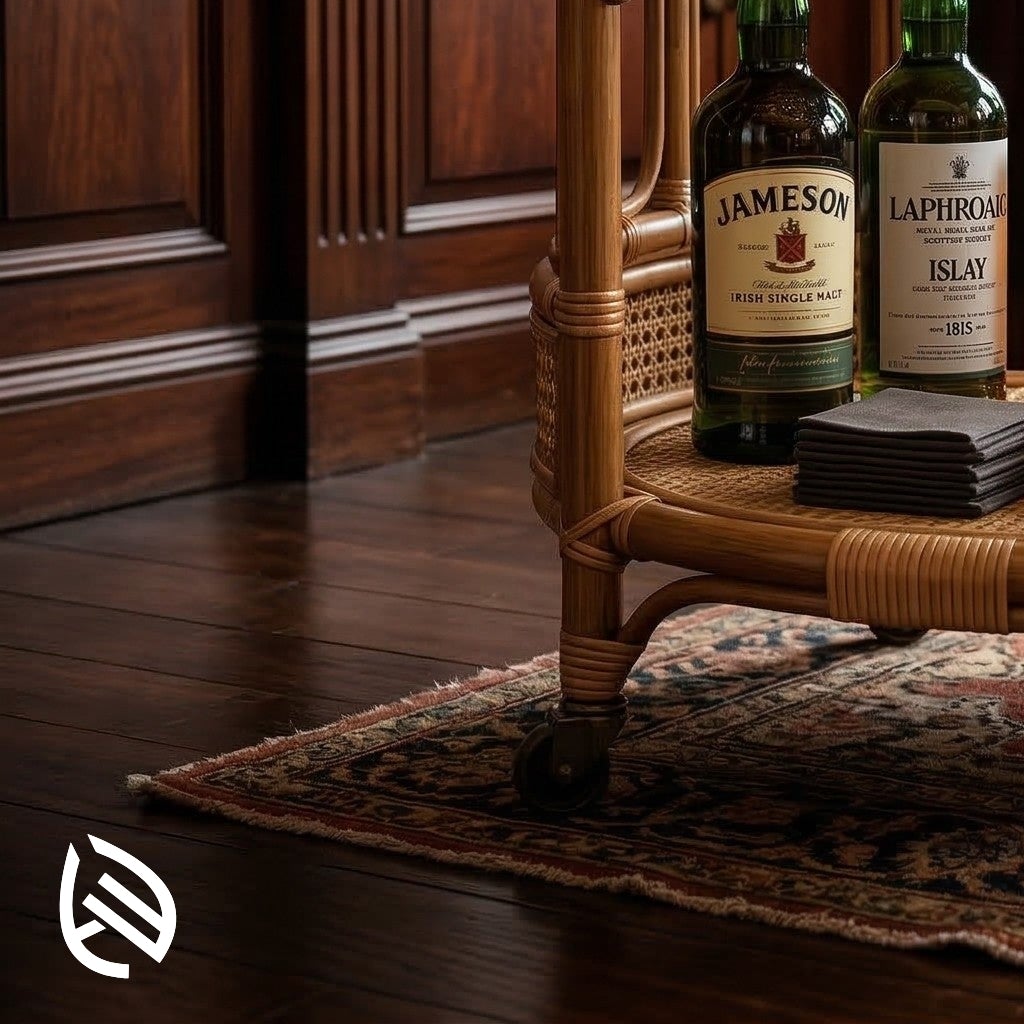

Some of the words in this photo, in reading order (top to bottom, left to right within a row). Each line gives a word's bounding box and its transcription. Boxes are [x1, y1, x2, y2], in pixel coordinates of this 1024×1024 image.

[717, 184, 850, 227] JAMESON
[929, 257, 987, 282] ISLAY
[730, 292, 763, 304] IRISH
[767, 292, 814, 304] SINGLE
